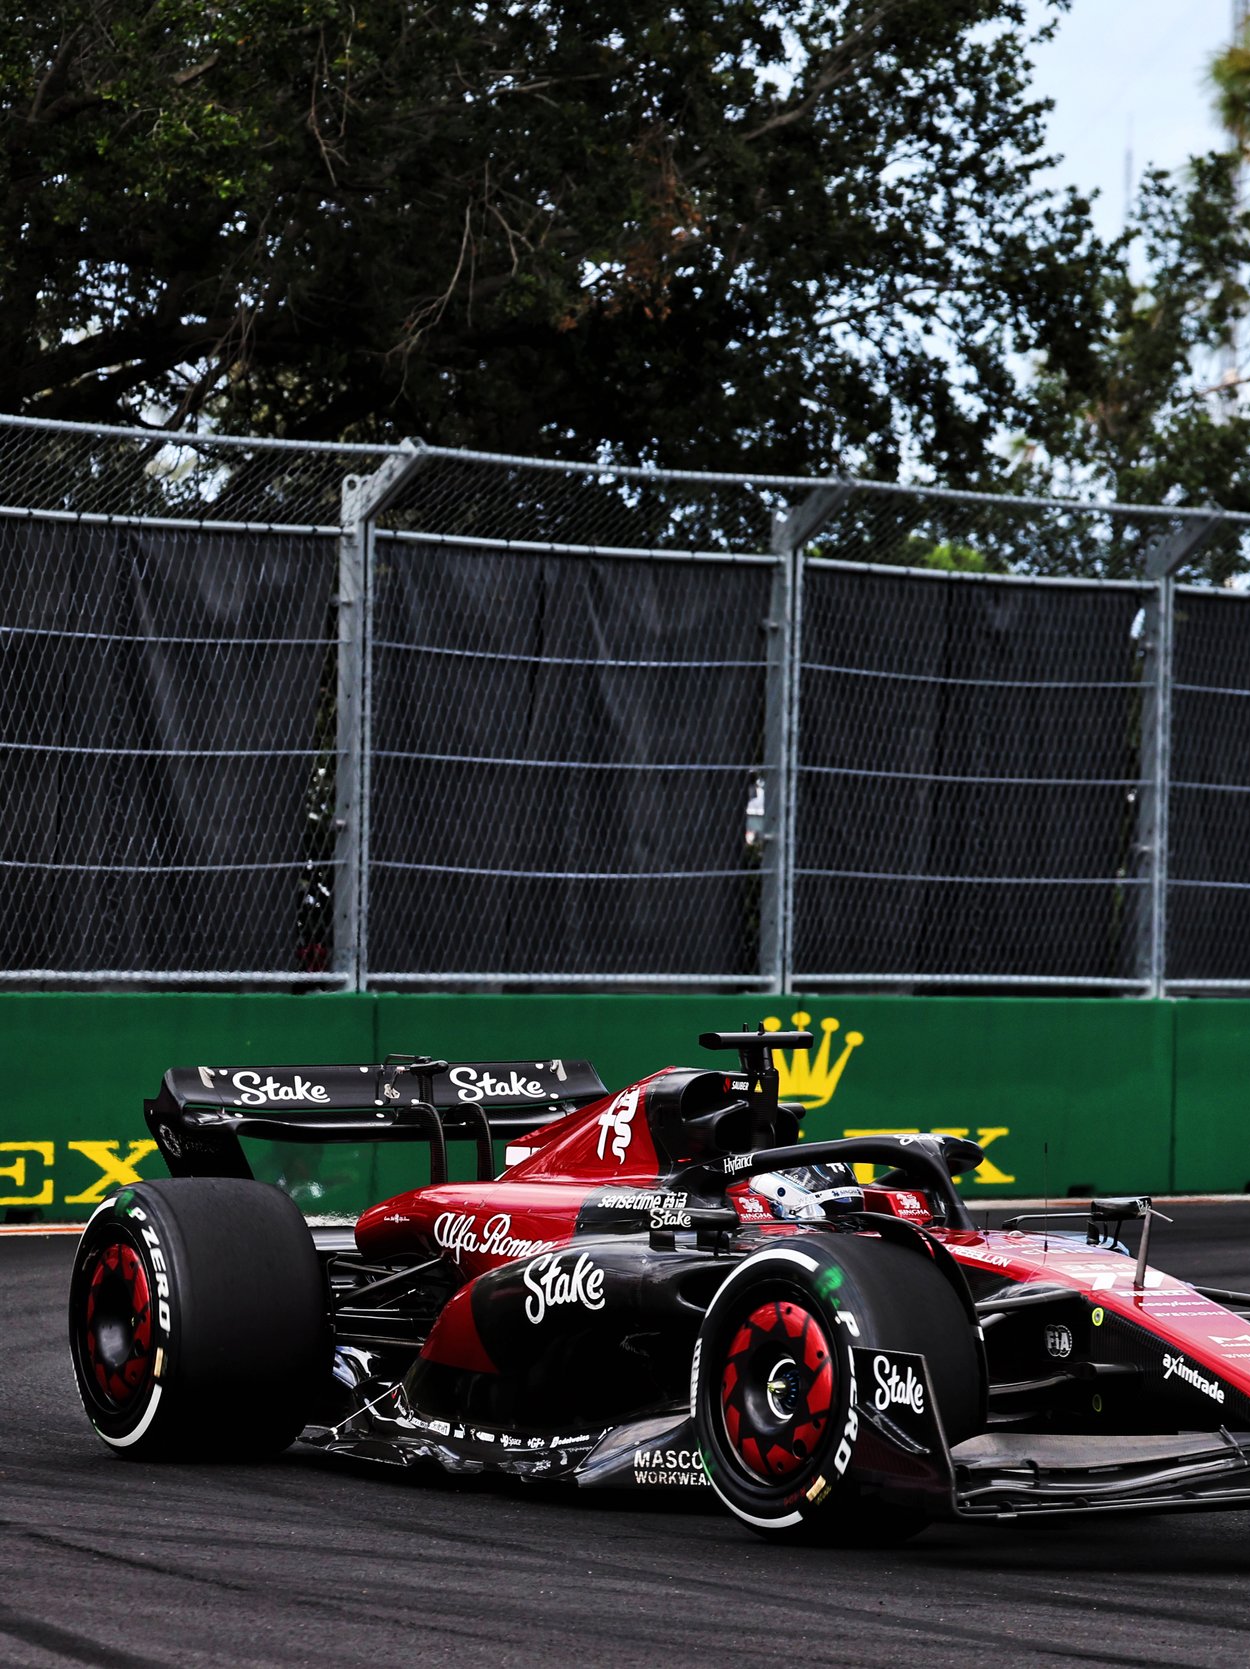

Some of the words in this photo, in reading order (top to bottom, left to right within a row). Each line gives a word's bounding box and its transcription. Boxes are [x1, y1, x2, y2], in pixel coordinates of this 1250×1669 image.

[232, 1070, 331, 1105] Stake
[450, 1066, 547, 1102] Stake
[731, 1080, 750, 1091] SAUBER
[723, 1154, 754, 1175] Hyland
[598, 1191, 662, 1210] sensetime
[650, 1207, 691, 1229] Stake
[433, 1211, 479, 1265] Alfa
[478, 1213, 560, 1258] Romeo
[128, 1206, 148, 1223] P
[141, 1225, 172, 1332] ZERO
[953, 1246, 1012, 1268] REBELLION
[523, 1252, 606, 1325] Stake
[873, 1355, 925, 1415] Stake
[1162, 1353, 1225, 1404] aximtrade
[634, 1470, 711, 1486] WORKWEA
